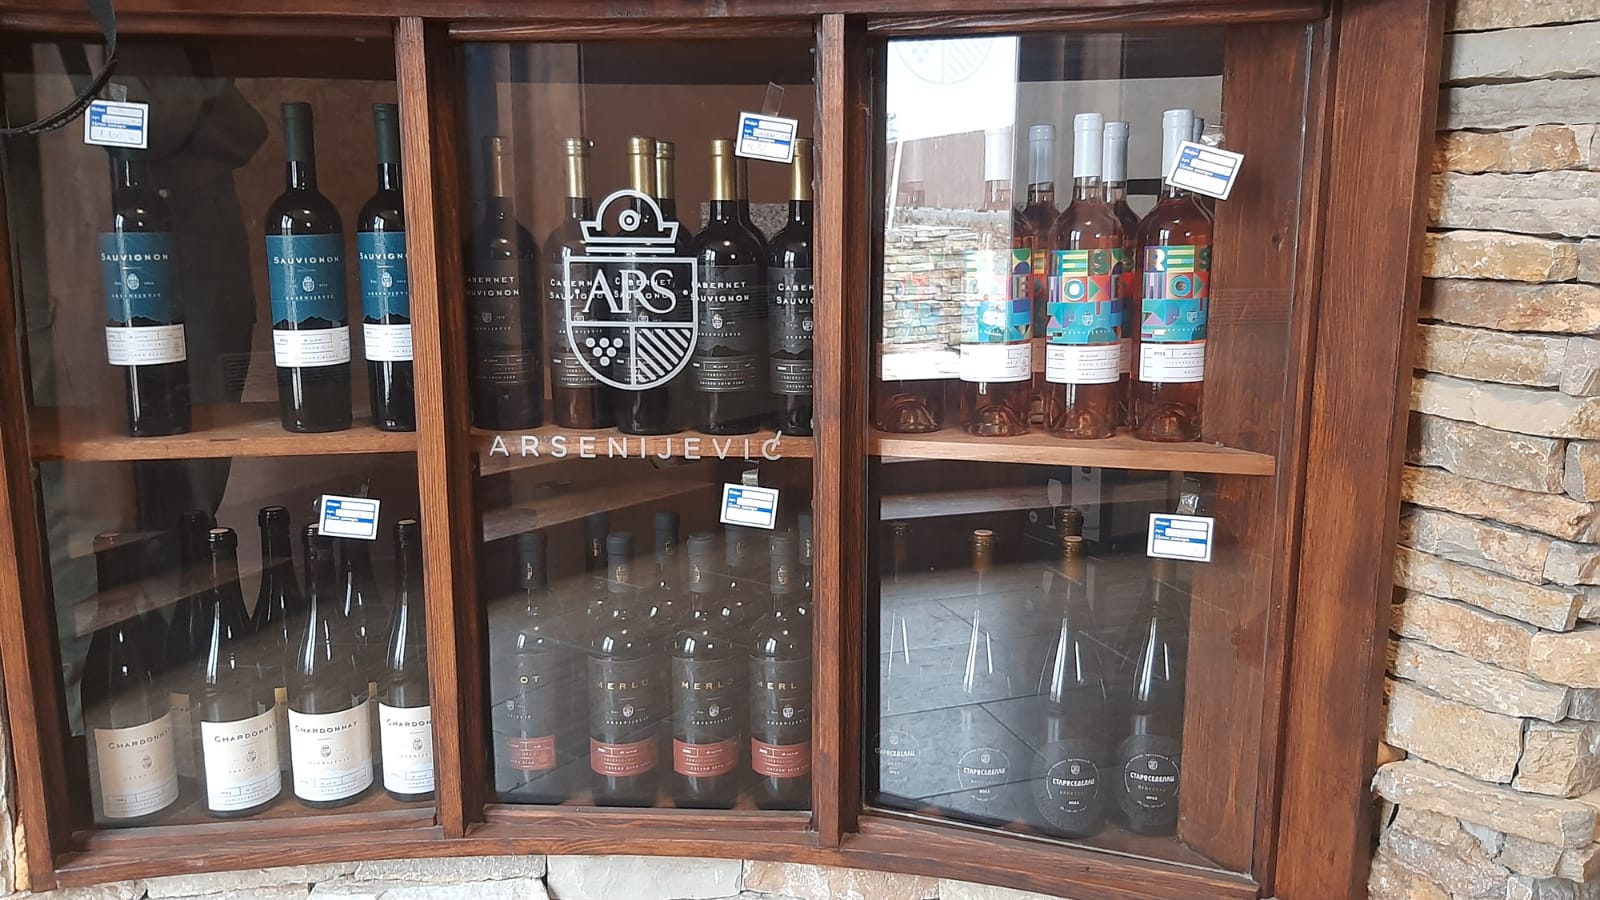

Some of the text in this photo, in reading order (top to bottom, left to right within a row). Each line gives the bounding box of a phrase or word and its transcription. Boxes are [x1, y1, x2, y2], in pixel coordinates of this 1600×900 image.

[100, 252, 169, 262] SAUVIGNON
[273, 256, 339, 265] SAUVIGNON
[359, 251, 408, 261] SAUVIGN
[581, 268, 677, 314] ARS
[488, 430, 783, 460] ARSENIJEVIĆ
[294, 720, 359, 734] CHARDONNAY
